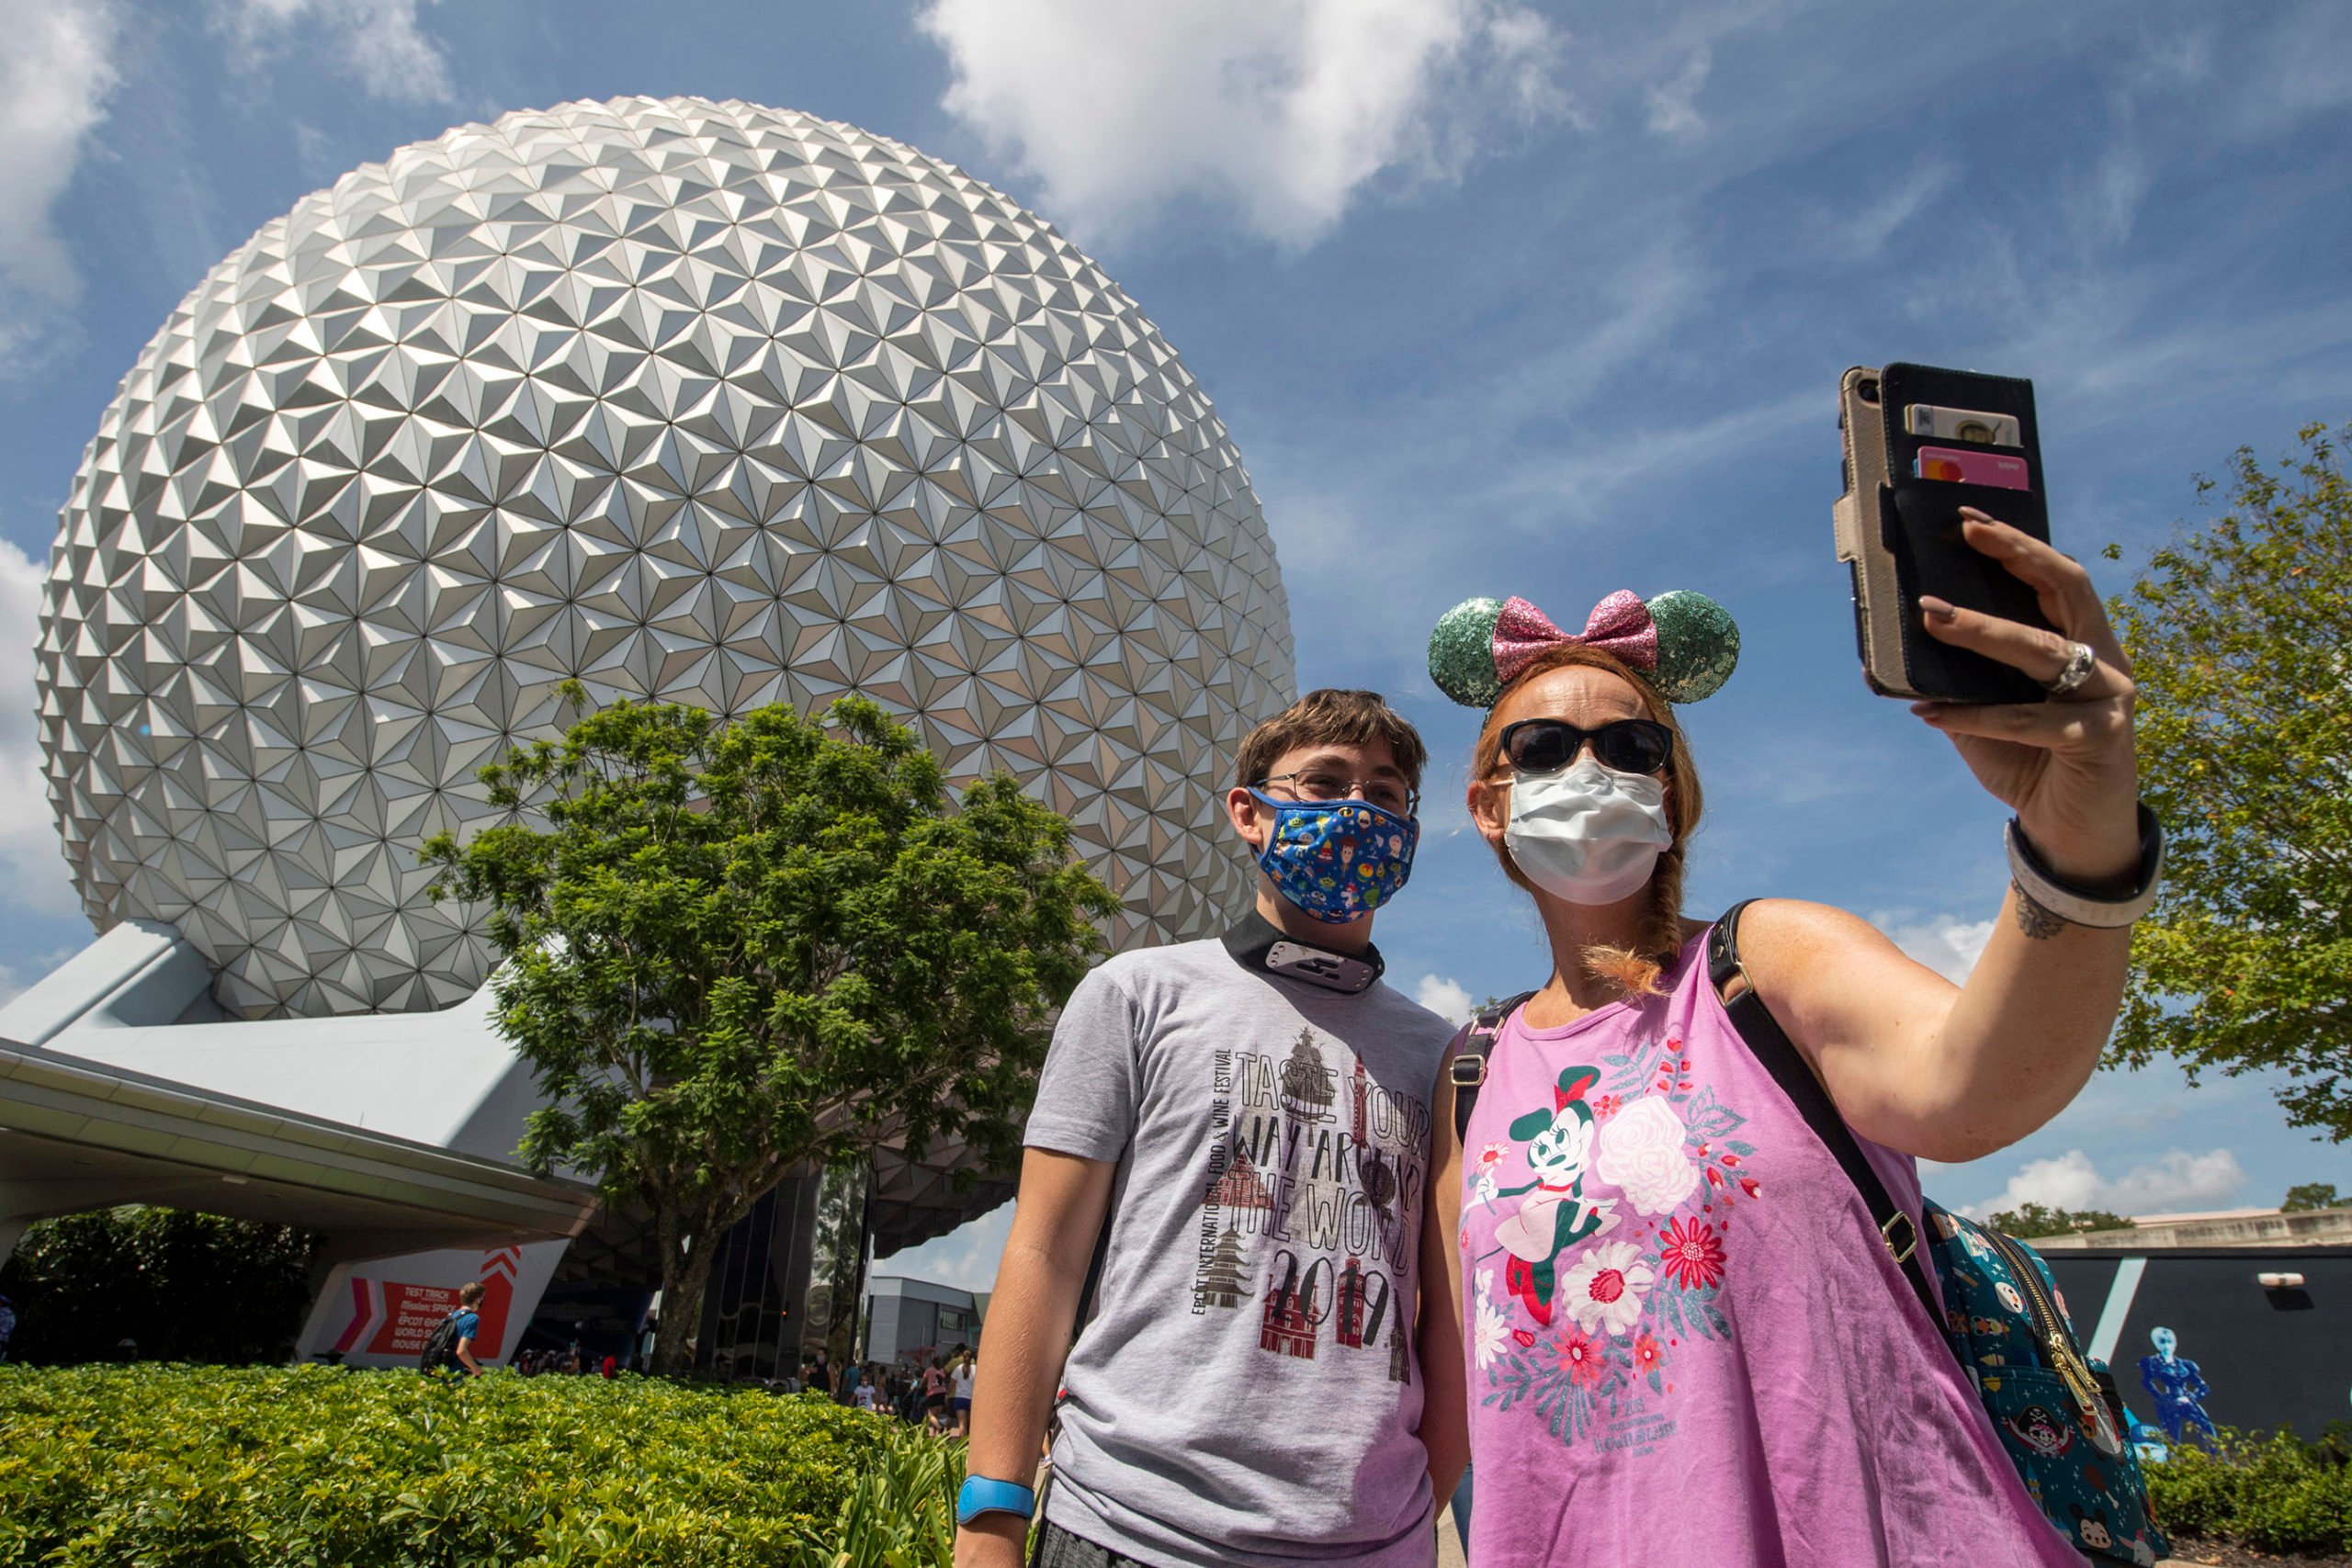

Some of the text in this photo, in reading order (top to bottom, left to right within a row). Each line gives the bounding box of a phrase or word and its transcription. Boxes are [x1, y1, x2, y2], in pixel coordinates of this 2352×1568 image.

[1235, 1052, 1430, 1161] TASTE YOUR
[1191, 1048, 1232, 1315] EPCOT INTERNATIONAL FOOD & WINE FESTIVAL
[1232, 1114, 1419, 1213] WAY AROUND
[1227, 1167, 1295, 1243] THE
[398, 1315, 424, 1327] EPCOT
[405, 1287, 424, 1298] TEST
[425, 1290, 449, 1300] TRACK
[1273, 1248, 1389, 1347] 2019
[391, 1339, 421, 1350] MOUSE
[395, 1327, 424, 1338] WORLD
